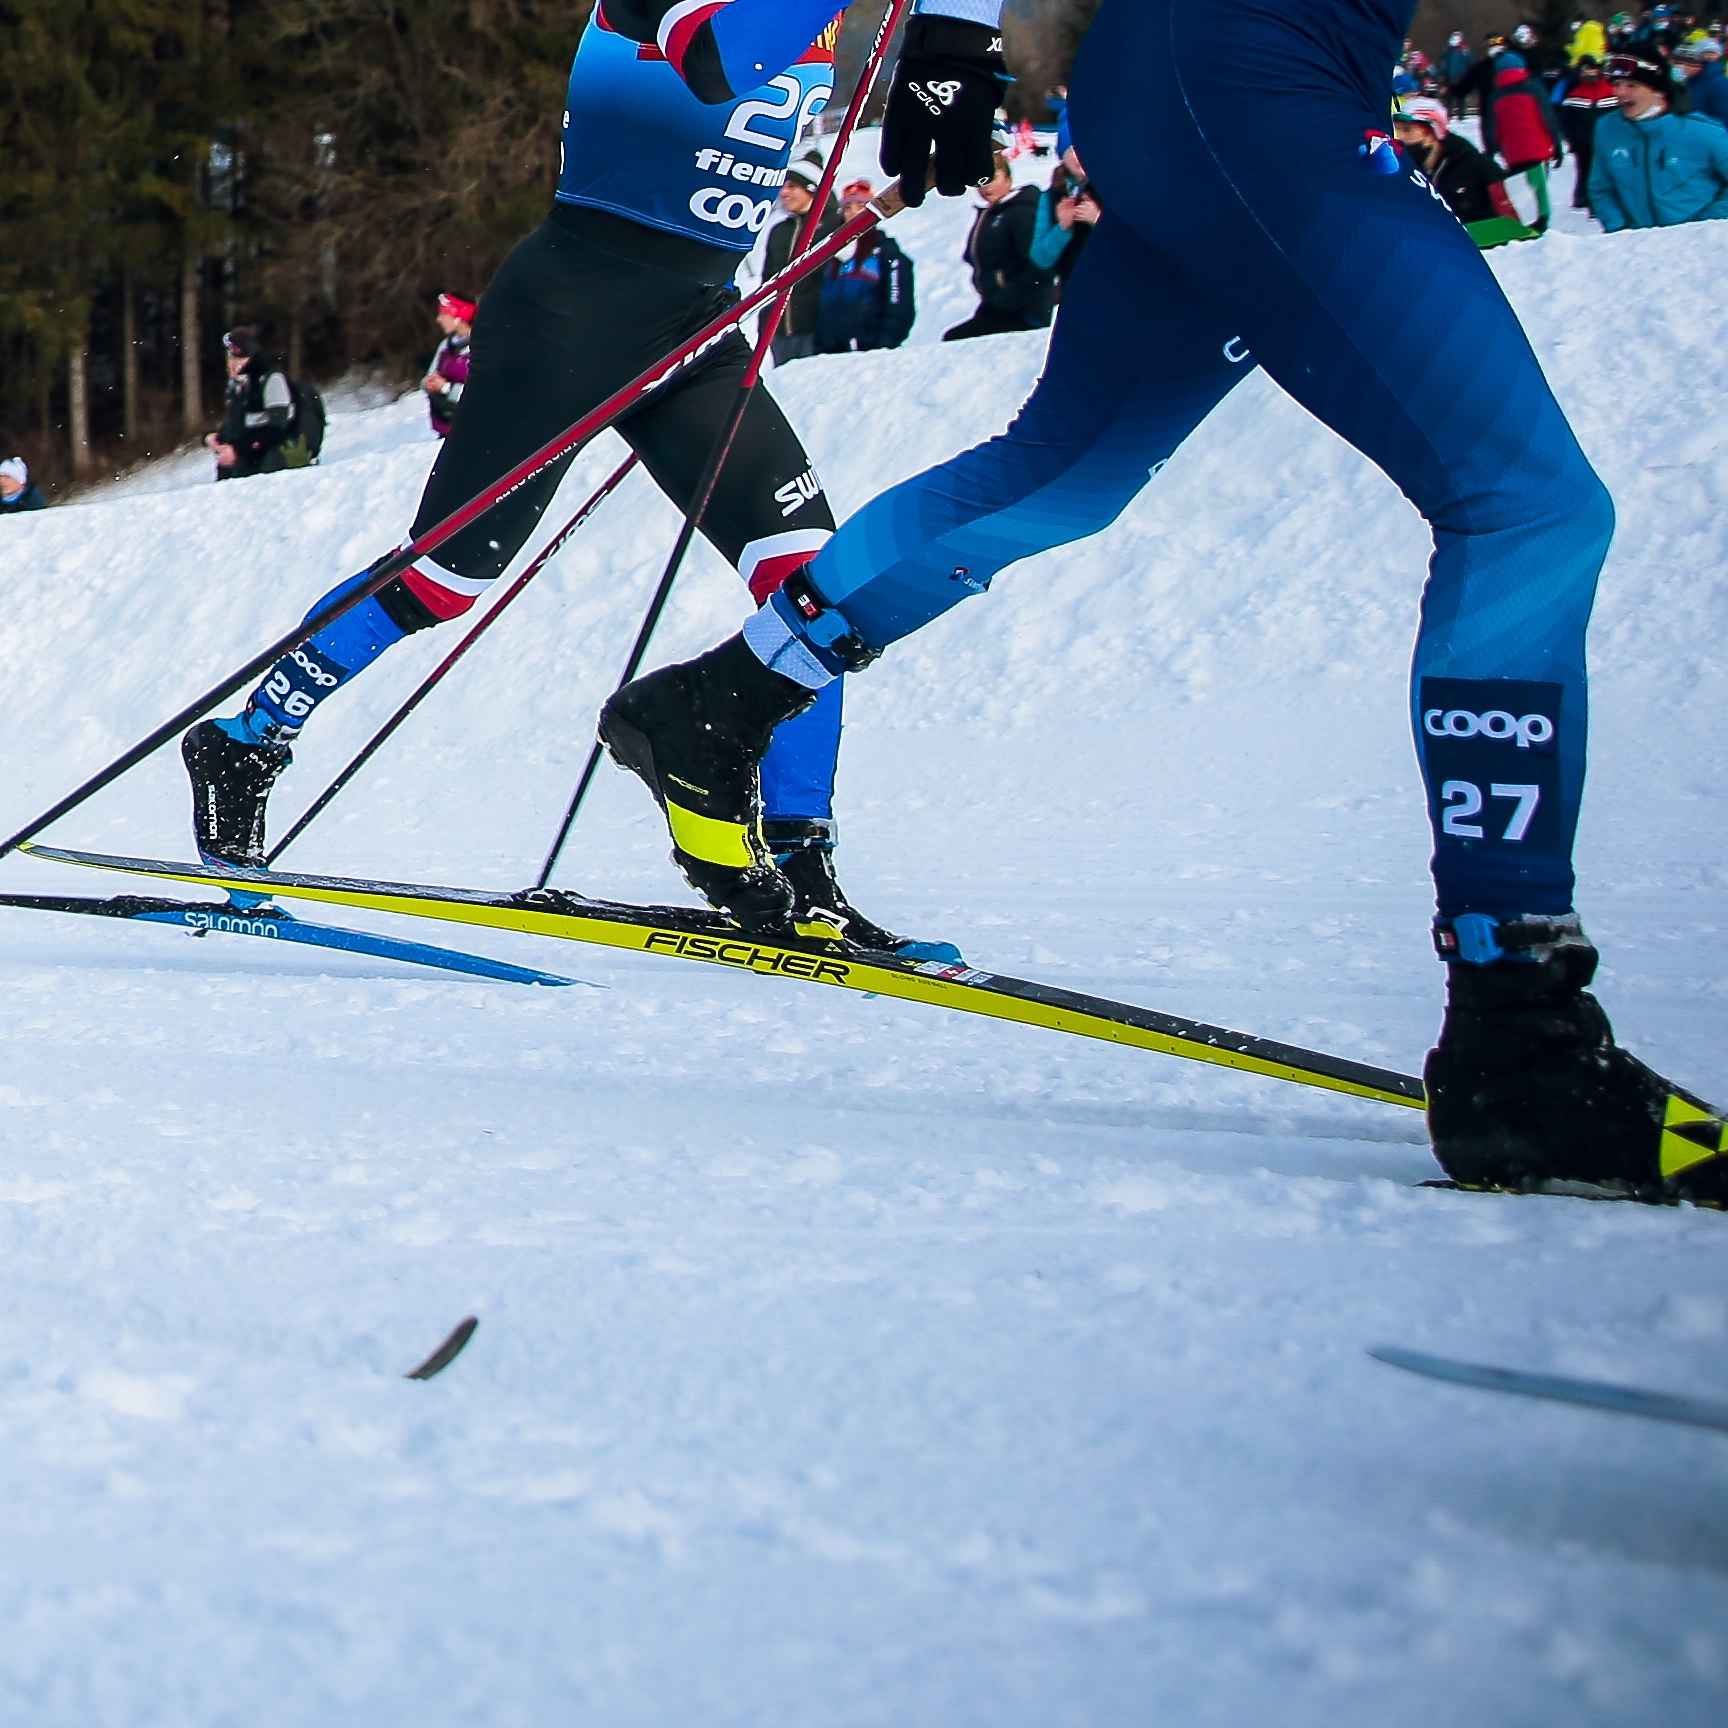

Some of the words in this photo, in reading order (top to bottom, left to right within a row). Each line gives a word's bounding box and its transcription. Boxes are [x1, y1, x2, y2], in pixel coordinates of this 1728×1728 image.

[908, 81, 941, 116] odlo
[689, 187, 775, 232] coo
[289, 650, 338, 687] oop
[263, 670, 315, 716] 26
[1424, 709, 1553, 748] coop
[1442, 780, 1539, 840] 27
[184, 911, 278, 940] salomon
[644, 931, 851, 985] FISCHER
